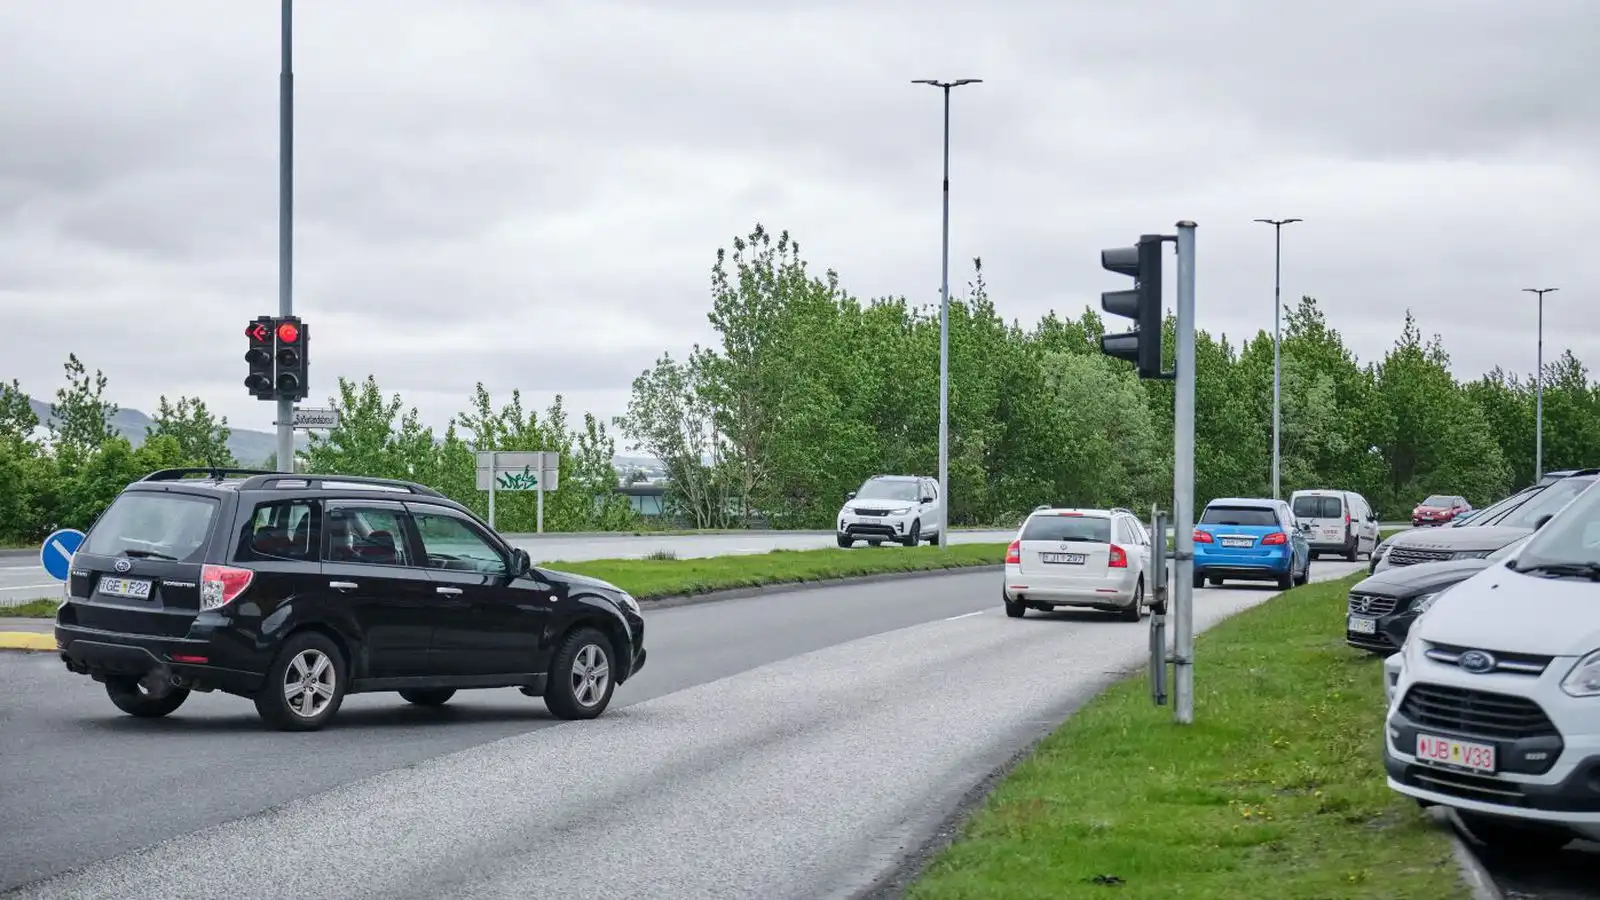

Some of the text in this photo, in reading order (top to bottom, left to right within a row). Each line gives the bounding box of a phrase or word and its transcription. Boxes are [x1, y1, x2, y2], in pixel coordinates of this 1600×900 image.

[106, 579, 149, 597] GE F22
[1427, 738, 1492, 769] UB V33
